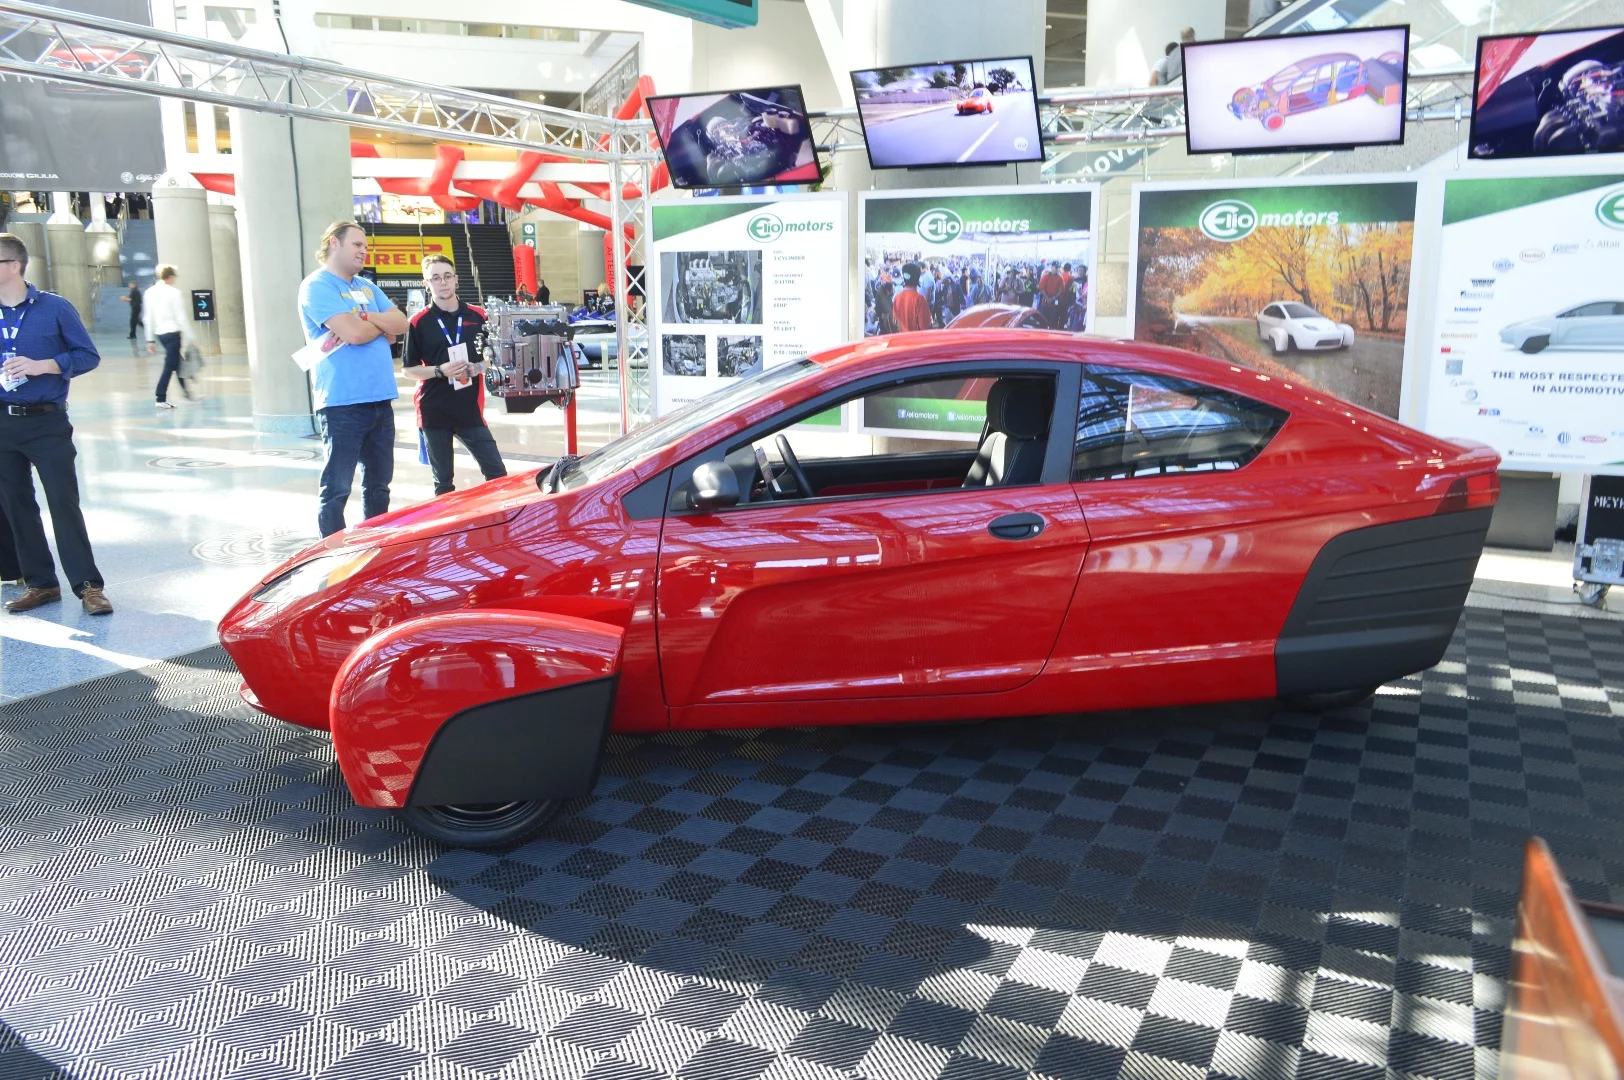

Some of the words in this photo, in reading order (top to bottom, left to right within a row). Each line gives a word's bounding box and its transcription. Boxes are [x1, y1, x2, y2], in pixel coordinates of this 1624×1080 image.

[918, 212, 961, 241] Elio
[965, 217, 1030, 232] motors
[1202, 204, 1254, 237] Elio
[1261, 209, 1339, 226] motors
[749, 216, 781, 239] Elio
[785, 220, 834, 232] motors
[365, 253, 428, 265] IREL
[1491, 370, 1515, 379] THE
[1519, 371, 1554, 380] MOST
[1559, 371, 1624, 382] RESPECTE
[1532, 385, 1545, 393] IN
[1549, 385, 1624, 395] AUTOMOTIV
[956, 413, 987, 421] /eliomotor
